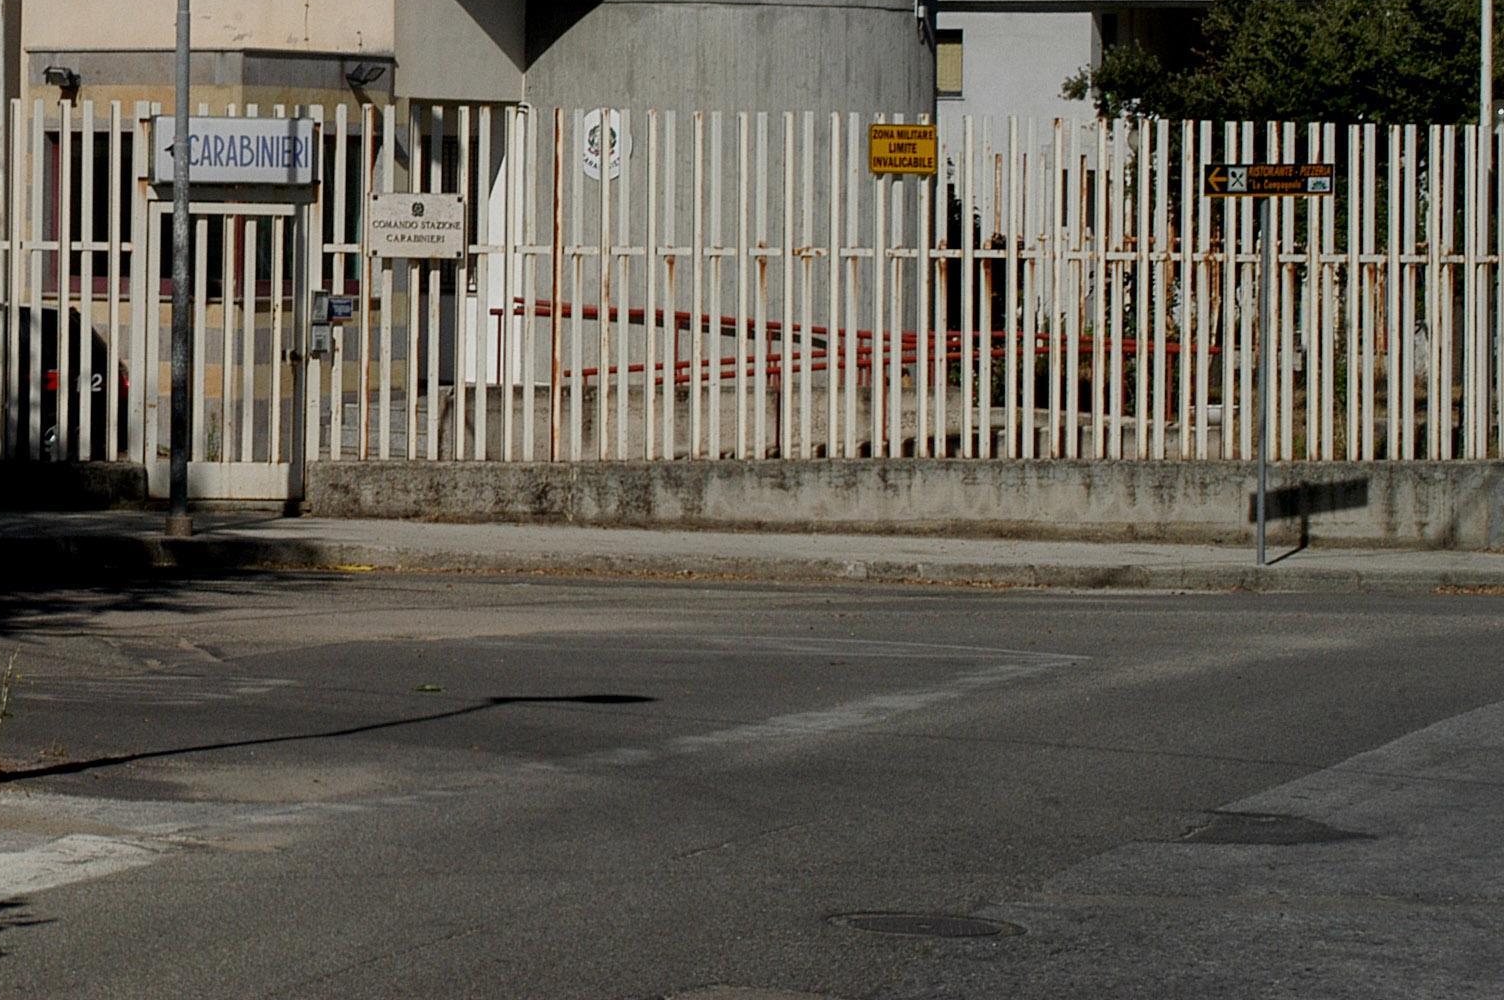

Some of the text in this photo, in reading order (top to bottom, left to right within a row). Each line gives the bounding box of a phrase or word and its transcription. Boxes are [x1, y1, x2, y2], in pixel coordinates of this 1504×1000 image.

[873, 129, 933, 140] ZONA MILITARE
[188, 134, 308, 168] CARABINIERI
[888, 142, 917, 154] LIMITE
[873, 156, 933, 168] INVALICABILE
[1248, 165, 1294, 177] RISTORANTE
[1300, 164, 1332, 177] PIZZERIA
[372, 220, 462, 230] COMANDO STAZIONE
[386, 234, 445, 243] CARABINIERI
